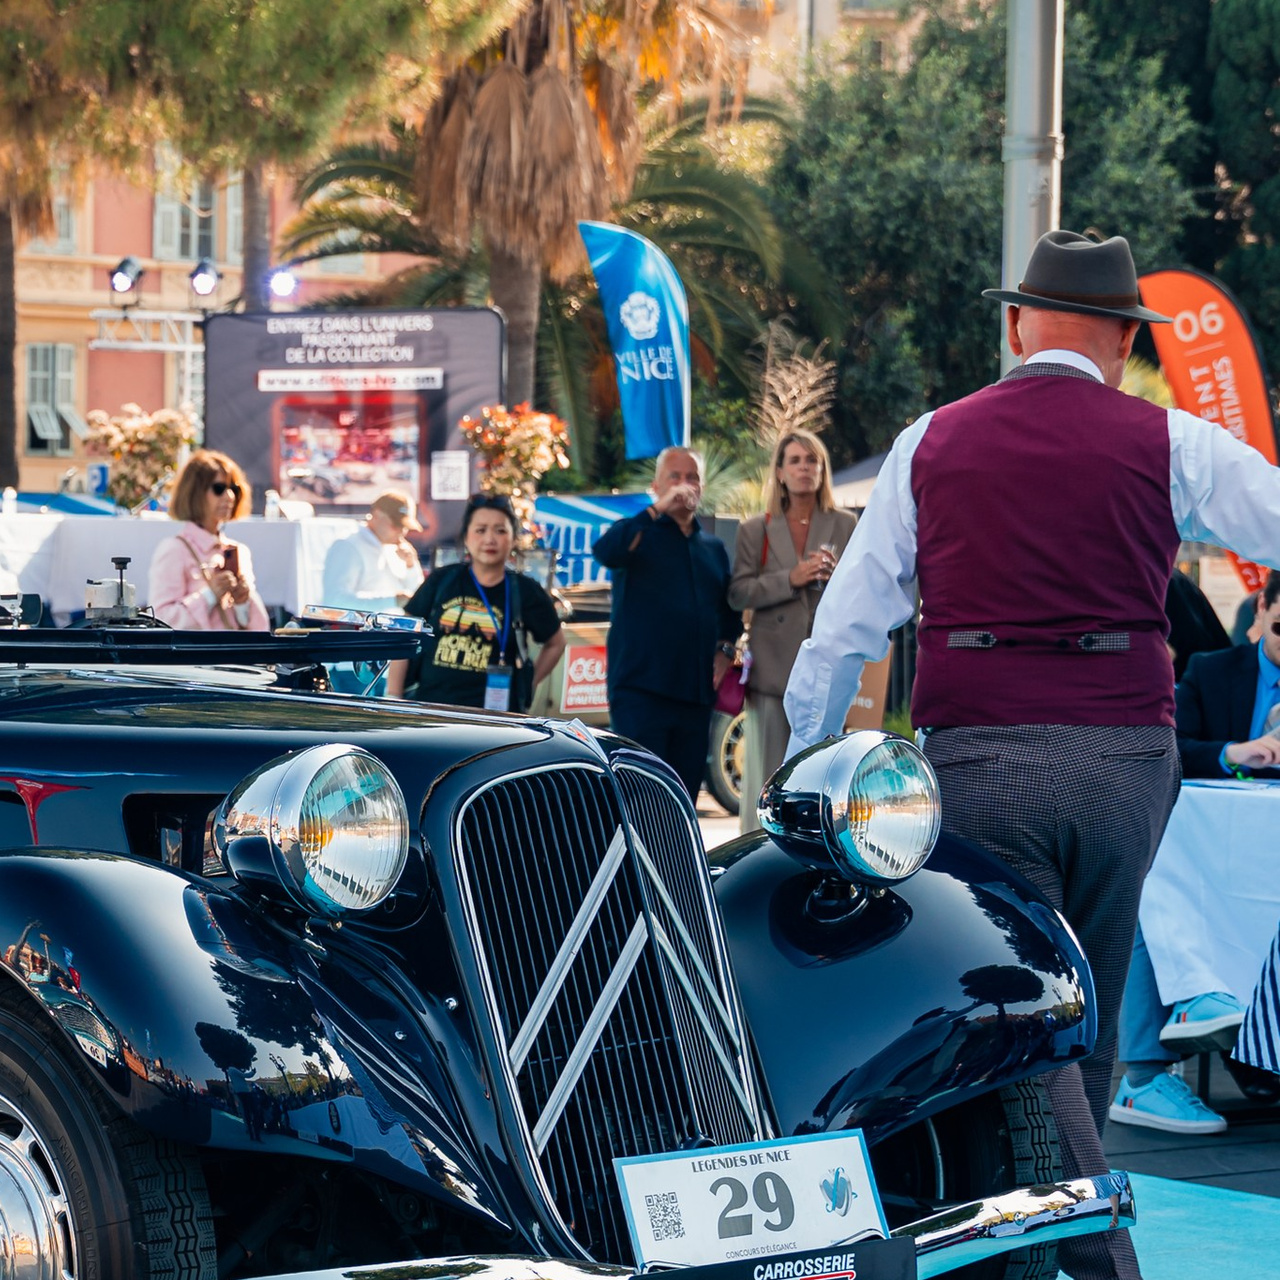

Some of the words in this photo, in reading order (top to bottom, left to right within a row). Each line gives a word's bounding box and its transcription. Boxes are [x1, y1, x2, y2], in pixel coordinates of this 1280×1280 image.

[267, 317, 321, 334] ENTREZ
[322, 316, 361, 333] DANS
[362, 315, 434, 332] L'UNIVERS
[1173, 301, 1225, 342] 06
[285, 348, 306, 363] DE
[307, 347, 326, 363] LA
[327, 346, 414, 362] COLLECTION
[620, 358, 674, 385] NICE
[691, 1154, 748, 1173] LEGENDES
[749, 1153, 766, 1166] DE
[766, 1149, 792, 1163] NICE
[708, 1170, 796, 1240] 29
[725, 1246, 761, 1259] CONCOURS
[760, 1241, 798, 1254] D'ÉLÉGANCE
